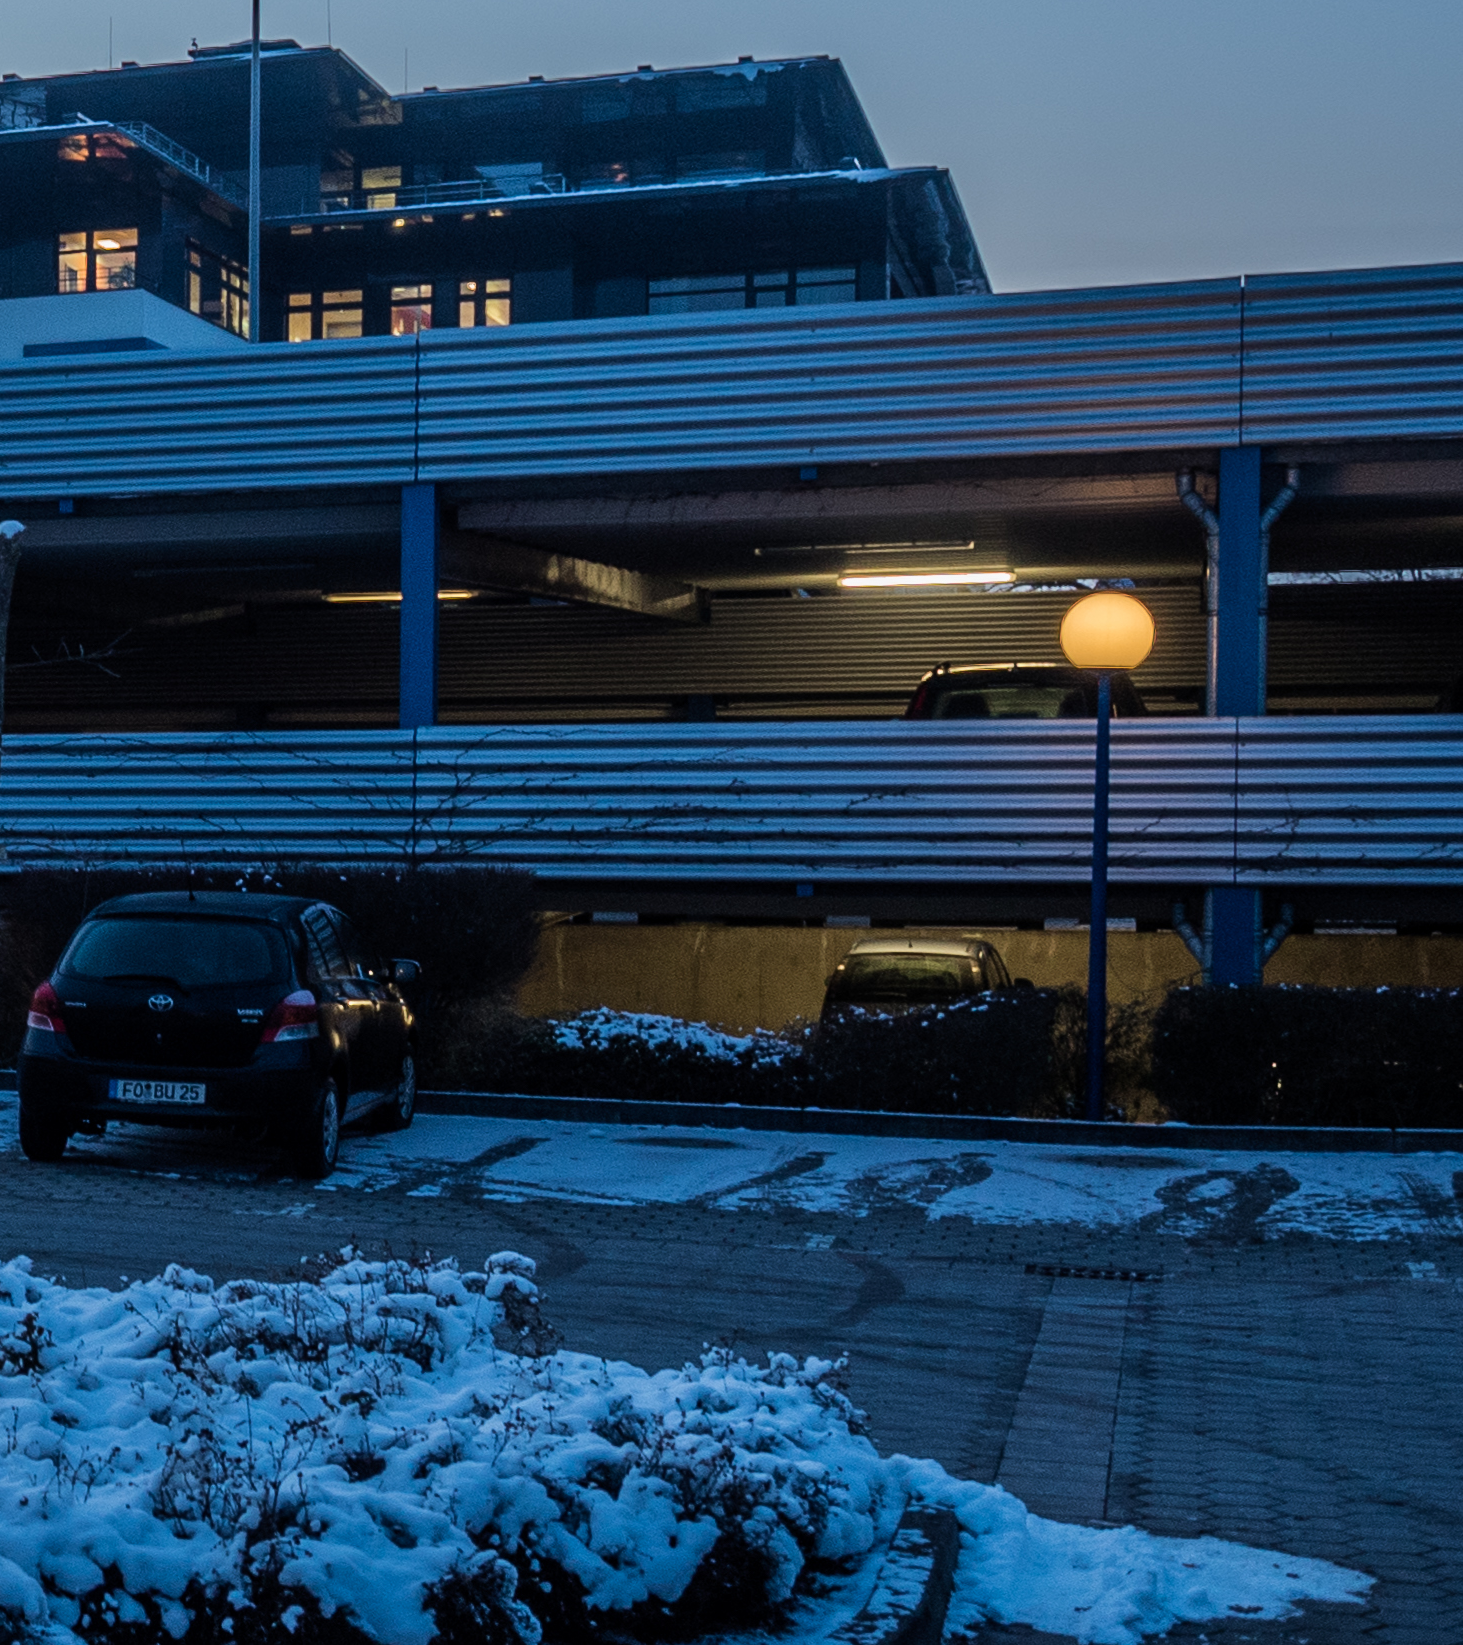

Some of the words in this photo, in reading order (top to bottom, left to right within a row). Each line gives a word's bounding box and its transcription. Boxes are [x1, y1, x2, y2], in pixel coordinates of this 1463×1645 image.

[122, 1082, 144, 1098] FO
[154, 1084, 175, 1099] BU
[179, 1085, 200, 1100] 25
